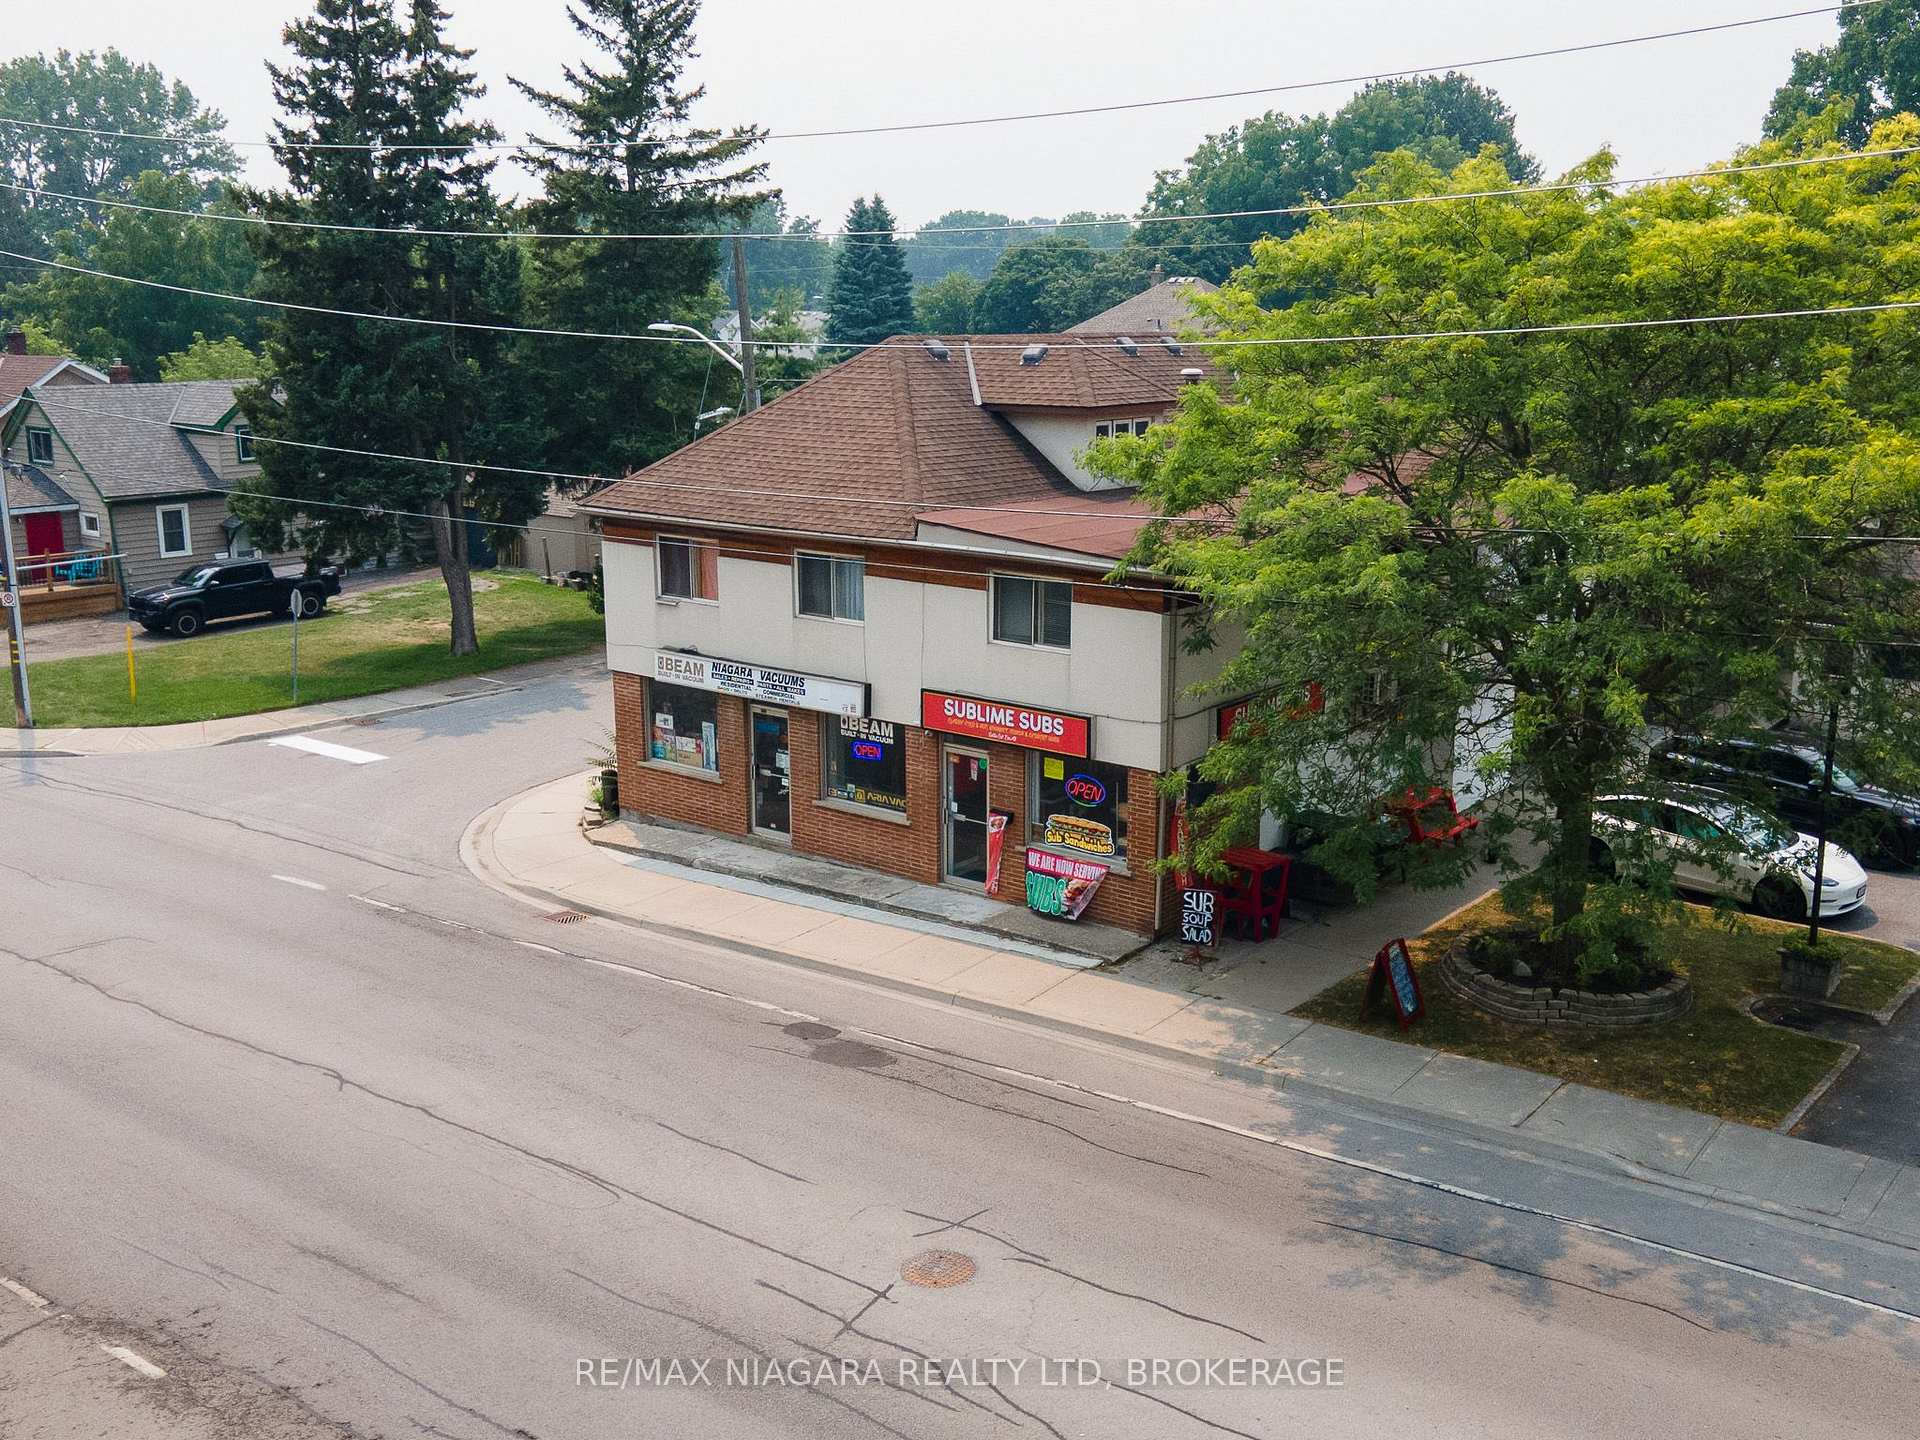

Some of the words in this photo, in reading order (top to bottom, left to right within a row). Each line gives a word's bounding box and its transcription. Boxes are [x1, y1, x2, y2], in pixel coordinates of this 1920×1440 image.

[665, 657, 704, 678] BEAM
[711, 662, 753, 679] NIAGARA
[760, 670, 805, 688] VACUUMS
[763, 689, 796, 700] COMMERCIAL
[849, 716, 894, 738] BEAM
[944, 698, 1015, 727] SUBLIME
[1018, 713, 1064, 736] SUBS
[854, 744, 881, 757] OPEN
[868, 734, 894, 745] VACUUM
[1068, 780, 1102, 802] OPEN
[1047, 831, 1061, 844] Sub
[1064, 834, 1112, 853] Sandwiches
[1028, 852, 1040, 868] WE
[1040, 855, 1055, 871] ARE
[1055, 859, 1074, 875] NOW
[1026, 870, 1067, 917] SUBS
[1183, 891, 1214, 914] SUB
[1182, 912, 1213, 927] SOUP
[1181, 925, 1212, 943] SALAD
